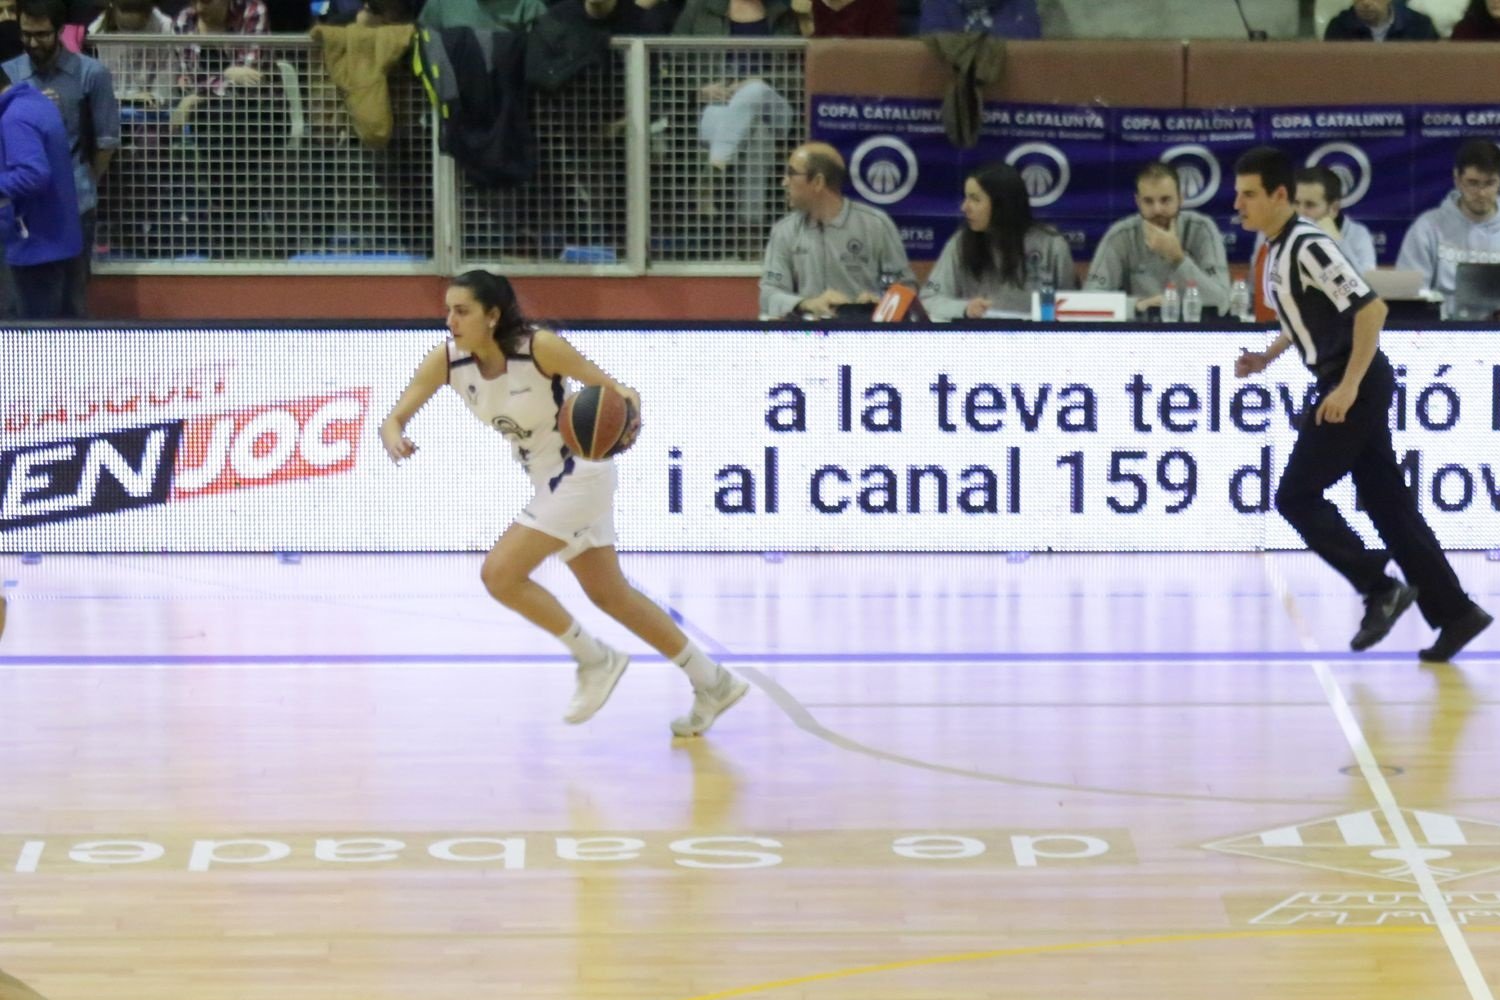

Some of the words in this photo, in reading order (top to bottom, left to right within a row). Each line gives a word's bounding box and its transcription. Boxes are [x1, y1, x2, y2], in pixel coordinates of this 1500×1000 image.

[818, 103, 859, 119] COPA
[863, 105, 944, 122] CATALUNY
[980, 110, 1011, 125] OPA
[1016, 112, 1105, 129] CATALUNYA
[1271, 115, 1312, 129] COPA
[1316, 113, 1405, 128] CATALUNYA
[1422, 113, 1463, 126] COPA
[1122, 115, 1161, 130] COPA
[1165, 116, 1254, 131] CATALUNYA
[765, 382, 807, 433] a
[837, 364, 902, 433] la
[929, 373, 1098, 433] teva
[1125, 363, 1462, 433] televió
[668, 446, 683, 514] i
[714, 446, 779, 515] al
[809, 446, 1021, 515] canal
[1056, 449, 1199, 515] 159
[1228, 445, 1273, 515] d
